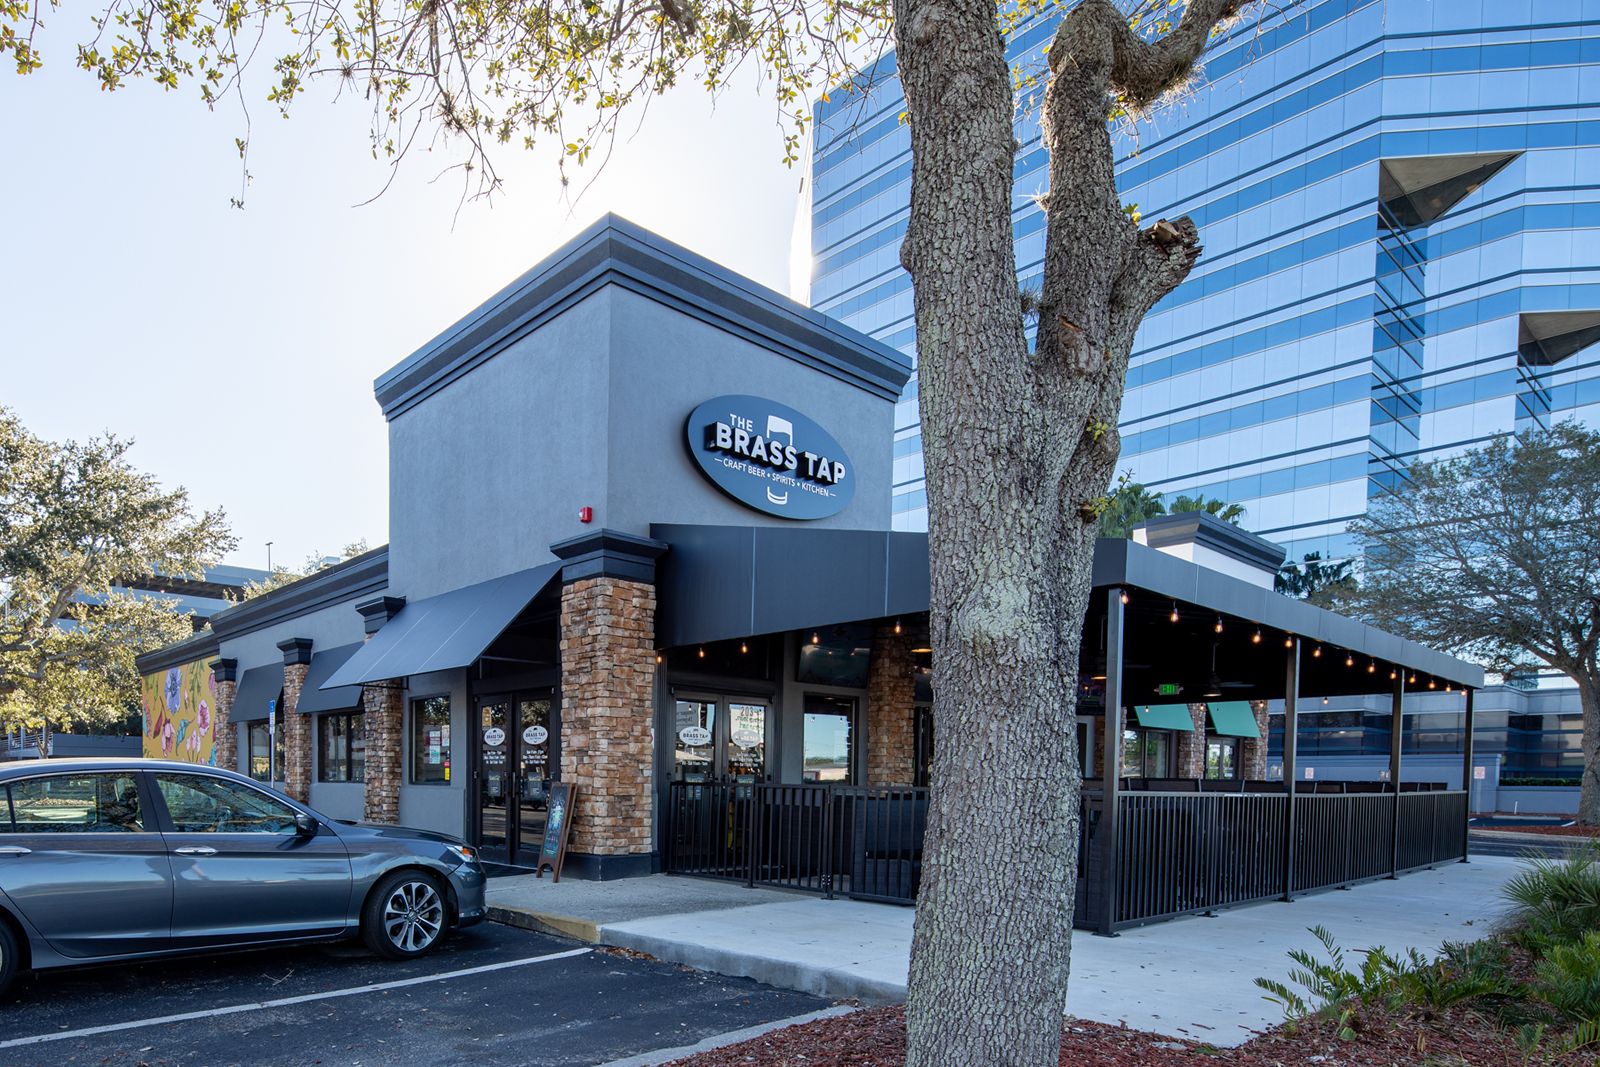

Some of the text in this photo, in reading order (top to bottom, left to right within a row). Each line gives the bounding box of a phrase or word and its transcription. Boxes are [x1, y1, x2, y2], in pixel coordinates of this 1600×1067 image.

[730, 414, 753, 432] THE
[717, 422, 846, 483] BRASS TAP
[723, 458, 829, 497] CRAFT BEER SPIRITS KITCHEN
